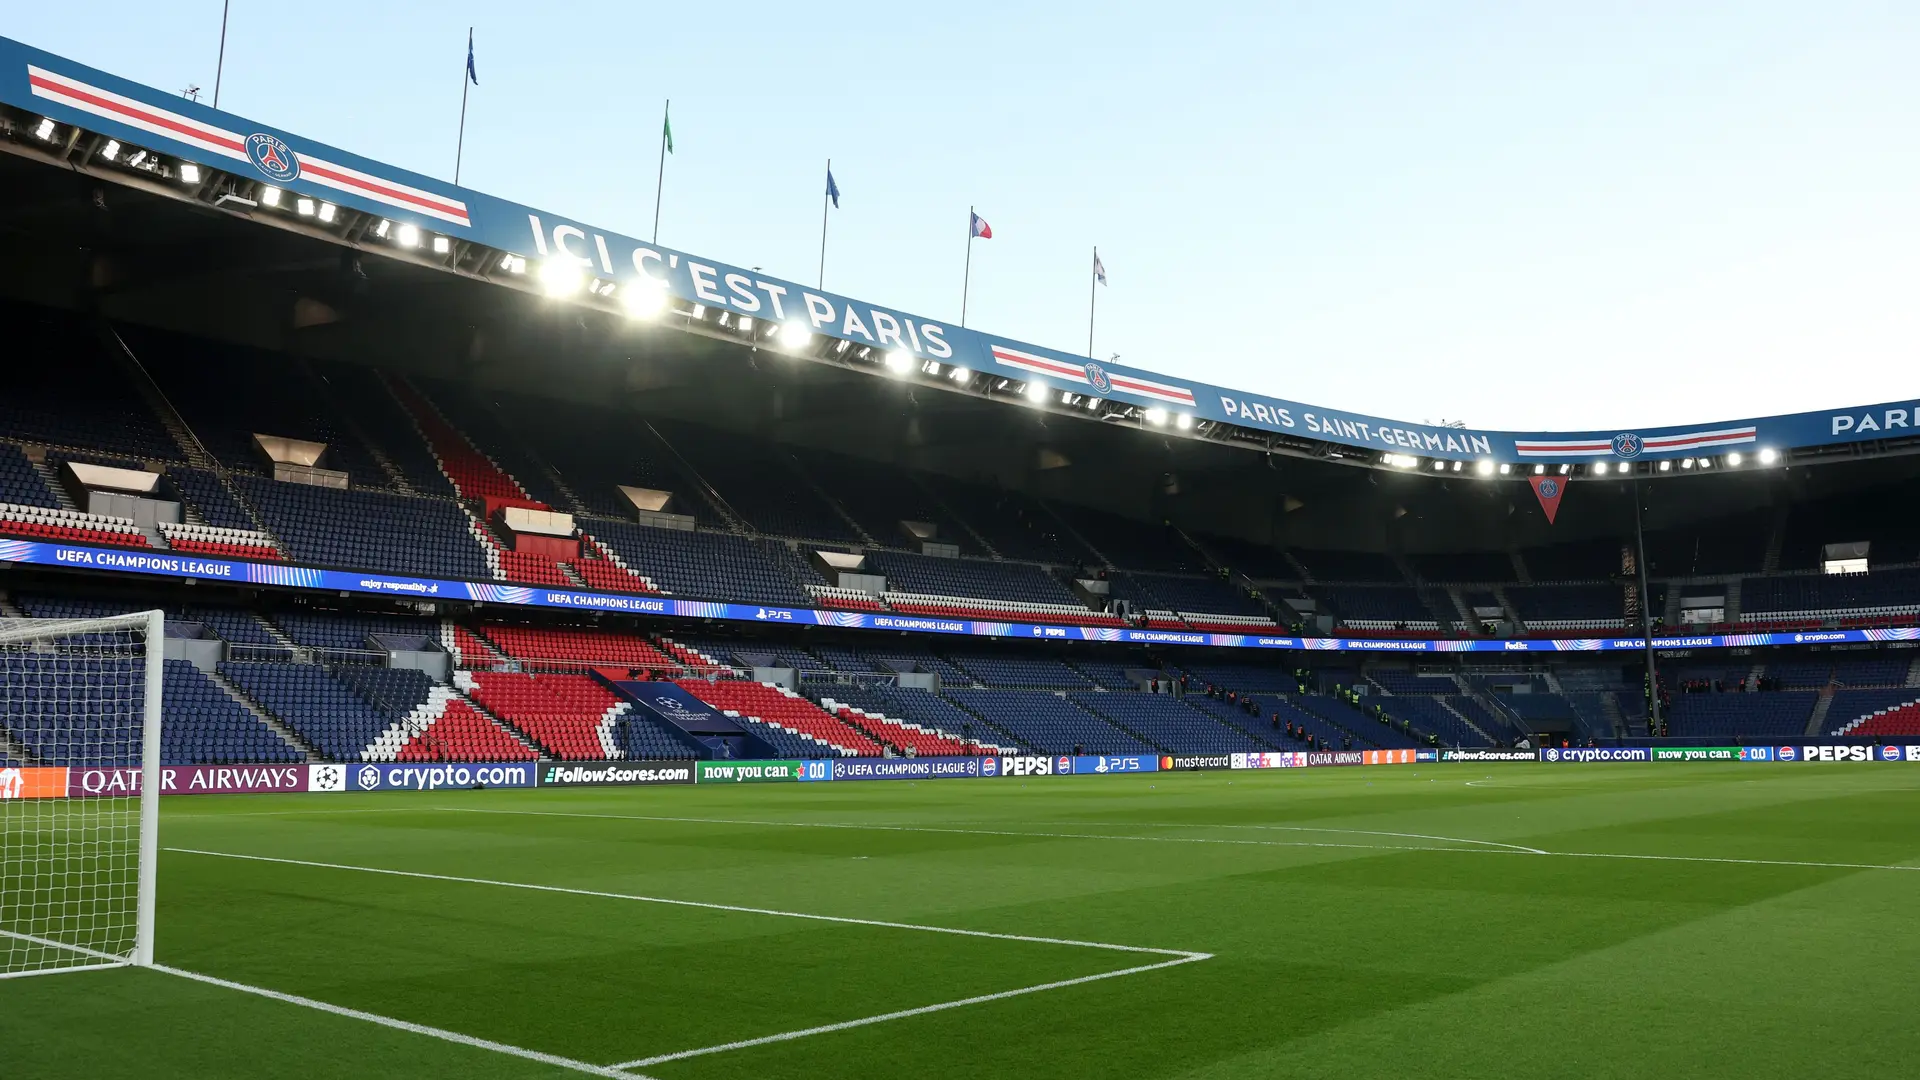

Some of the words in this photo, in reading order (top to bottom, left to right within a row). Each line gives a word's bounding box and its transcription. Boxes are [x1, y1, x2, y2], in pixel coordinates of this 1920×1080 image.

[252, 135, 287, 152] PARIS
[529, 214, 613, 274] ICI
[632, 247, 787, 320] C'EST
[803, 292, 952, 358] PARIS
[1221, 396, 1295, 428] PARIS
[1304, 413, 1491, 454] SAINT-GERMAIN
[56, 549, 93, 564] UEFA
[96, 553, 179, 572] CHAMPIONS
[181, 561, 231, 576] LEAGUE
[360, 579, 382, 589] enjoy
[383, 581, 427, 593] responsibly
[547, 593, 571, 604] UEFA
[573, 595, 628, 609] CHAMPIONS
[630, 600, 664, 611] LEAGUE
[768, 611, 791, 619] PS5
[874, 617, 893, 627] UEFA
[894, 619, 936, 630] CHAMPIONS
[937, 622, 963, 631] LEAGUE
[1045, 628, 1066, 636] PEPSI
[1129, 632, 1145, 640] UEFA
[1146, 632, 1181, 642] CHAMPIONS
[1181, 635, 1204, 643] LEAGUE
[1804, 633, 1846, 642] crypto.com
[1363, 641, 1400, 649] CHAMPIONS
[1400, 642, 1426, 650] LEAGUE
[1634, 639, 1681, 648] CHMPIONS
[1682, 638, 1713, 646] LEAGUE
[1280, 752, 1304, 767] FedEx
[1309, 754, 1332, 765] QATAR
[1334, 753, 1361, 764] AIRWAYS
[1448, 750, 1535, 760] FollowScores.com
[1563, 748, 1645, 762] crypto.com
[1658, 750, 1682, 759] now
[1684, 750, 1707, 761] you
[1709, 750, 1731, 759] can
[1803, 745, 1873, 761] PEPSI
[1002, 756, 1052, 775] PEPSI
[1111, 758, 1139, 769] PS5
[1175, 755, 1228, 768] mastercard
[1246, 753, 1271, 768] FedEx
[554, 763, 689, 783] FollowScores.com
[704, 766, 734, 778] now
[737, 766, 762, 781] you
[764, 765, 788, 777] can
[847, 764, 873, 775] UEFA
[875, 763, 930, 775] CHAMPIONS
[932, 761, 965, 773] LEAGUE
[82, 769, 177, 793] QATR
[189, 768, 298, 789] AIRWAYS
[388, 764, 526, 789] crypto.com
